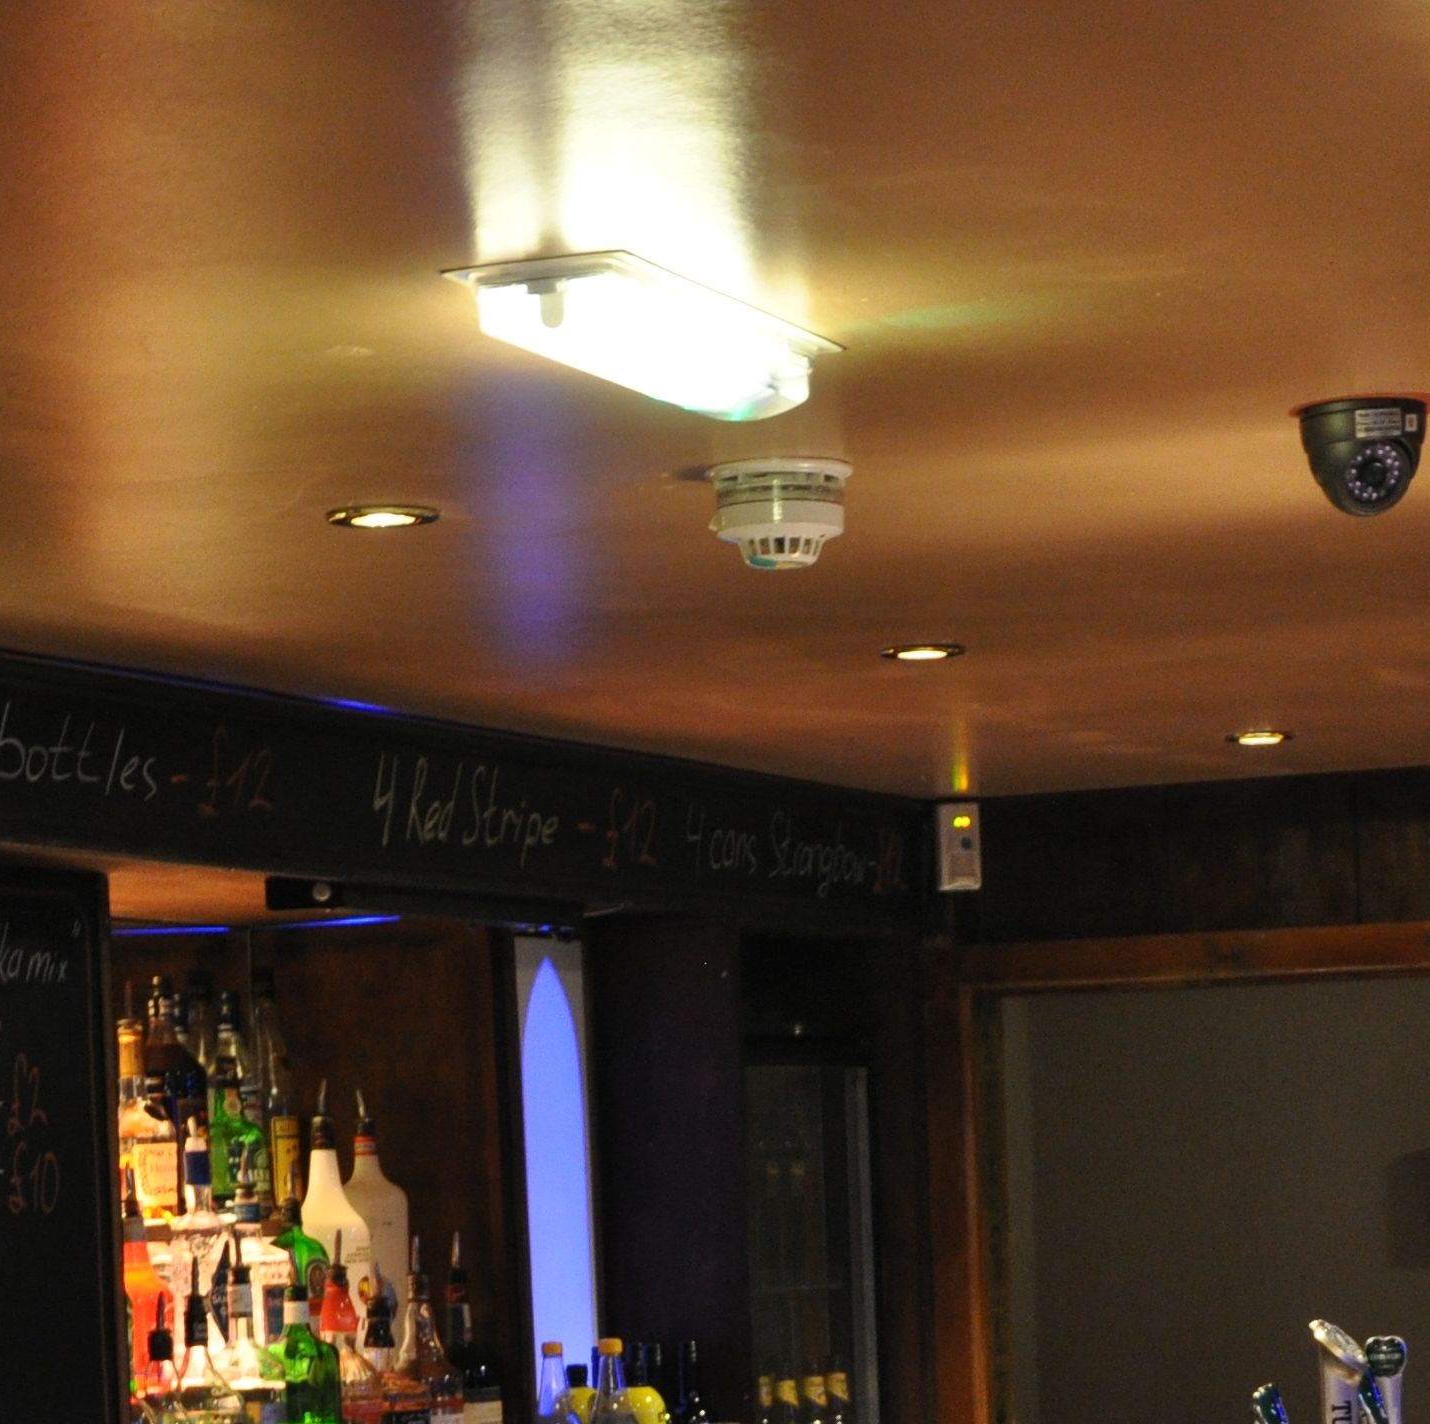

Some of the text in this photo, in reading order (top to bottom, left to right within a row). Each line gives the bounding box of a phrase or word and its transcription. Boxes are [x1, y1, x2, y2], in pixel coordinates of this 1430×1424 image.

[371, 752, 397, 847] 4
[406, 757, 463, 845] Red
[462, 763, 558, 867] Stripe
[686, 804, 708, 875] 4
[709, 827, 757, 872] cans
